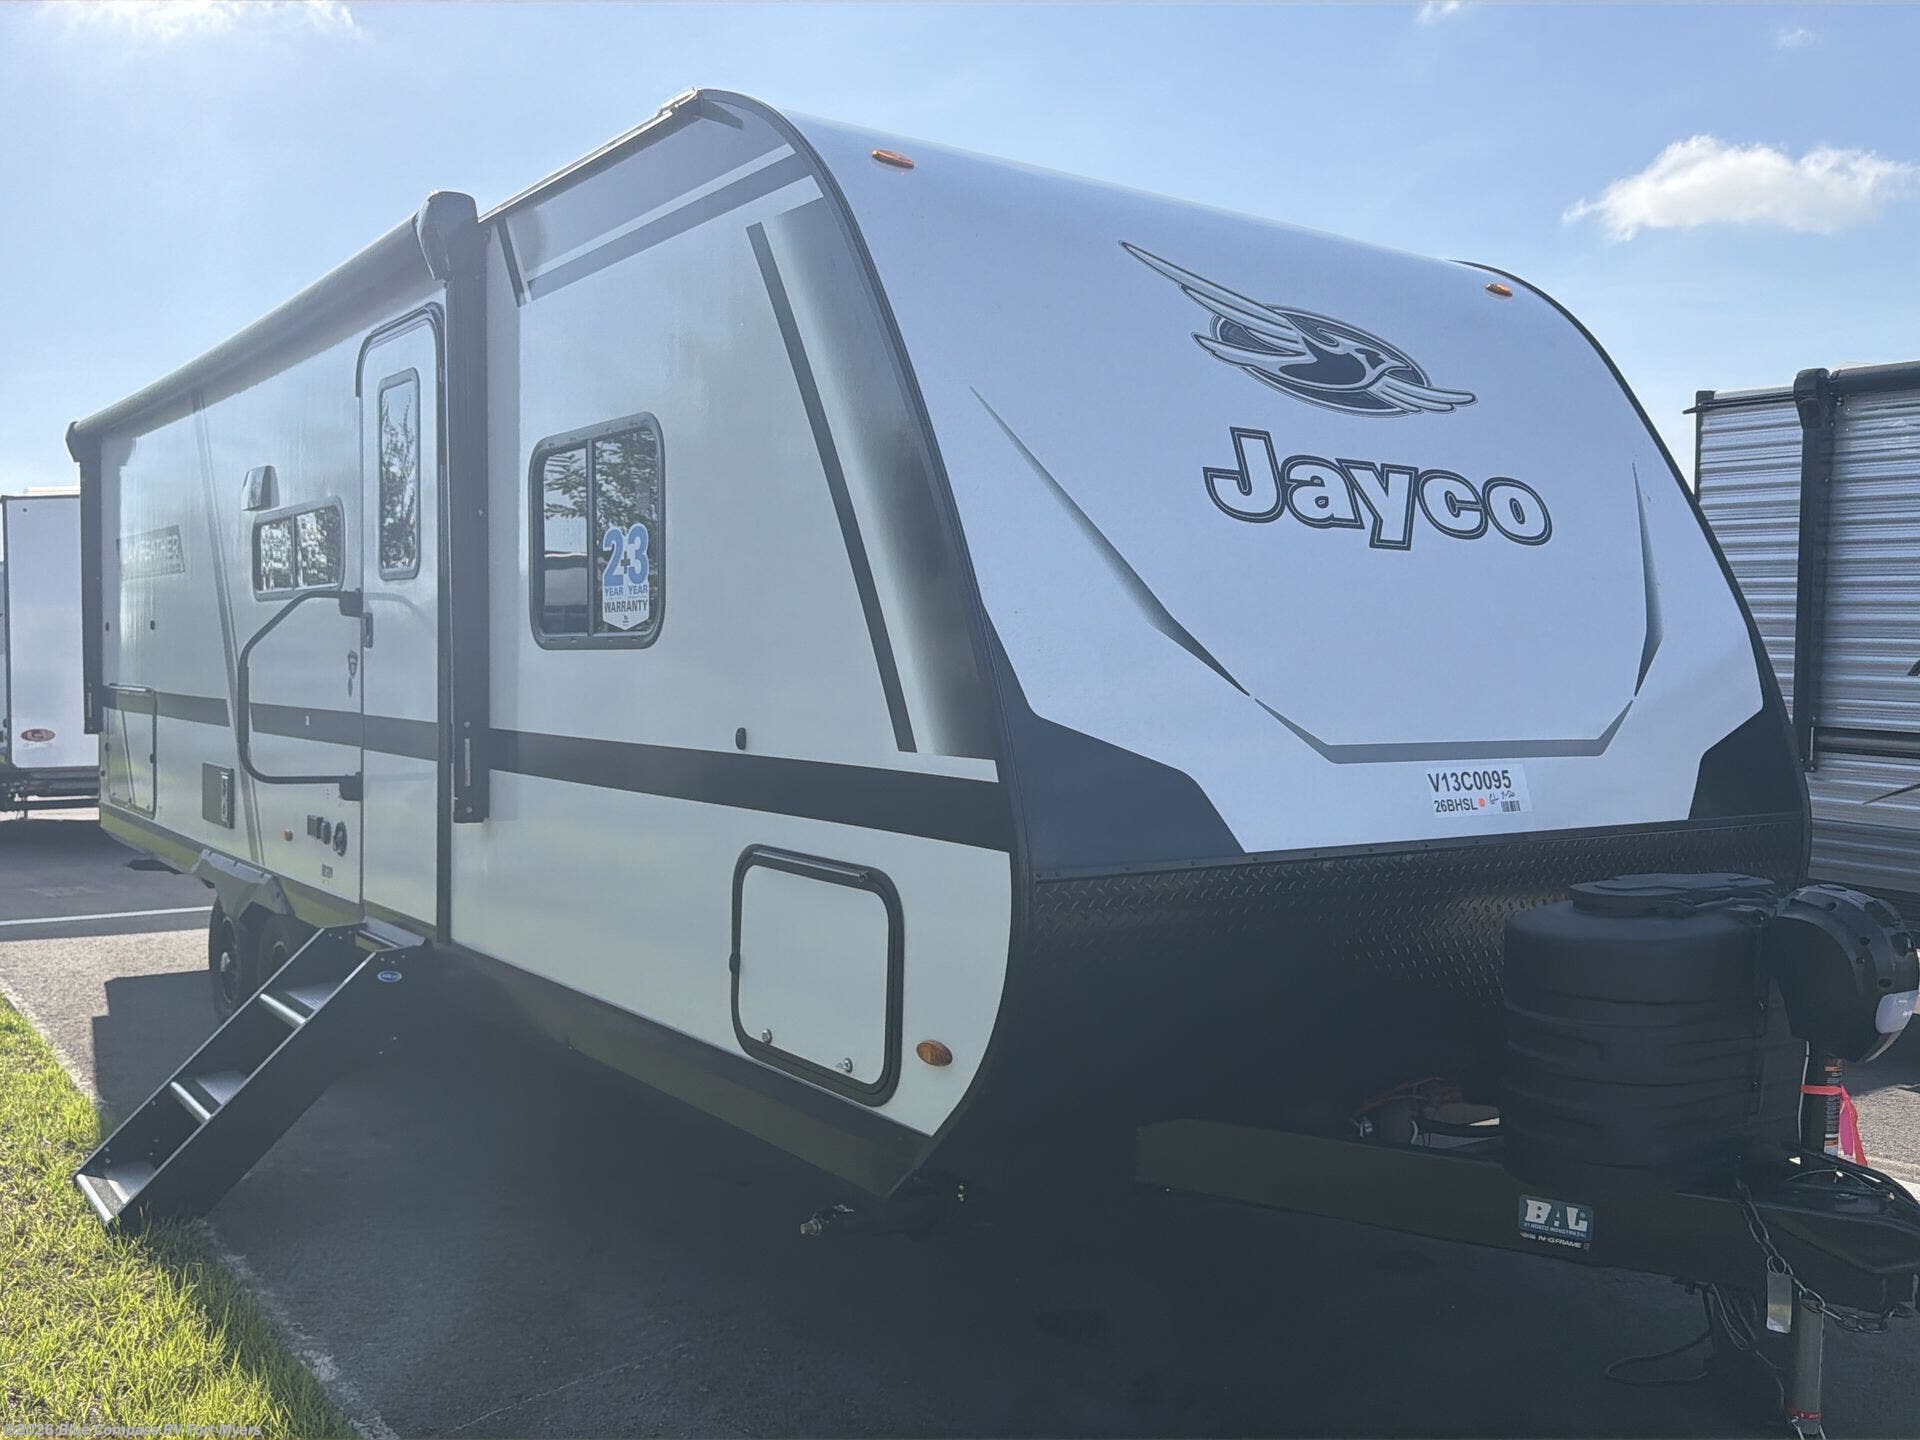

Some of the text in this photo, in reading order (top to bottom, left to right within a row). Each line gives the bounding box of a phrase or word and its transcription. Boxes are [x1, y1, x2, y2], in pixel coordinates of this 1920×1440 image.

[1203, 426, 1552, 551] Jayco
[605, 584, 648, 597] YEAR YEAR
[604, 599, 648, 613] WARRANTY
[1427, 769, 1512, 793] V13C0095
[1434, 798, 1478, 813] 26BHSL
[1524, 1199, 1588, 1233] BAL
